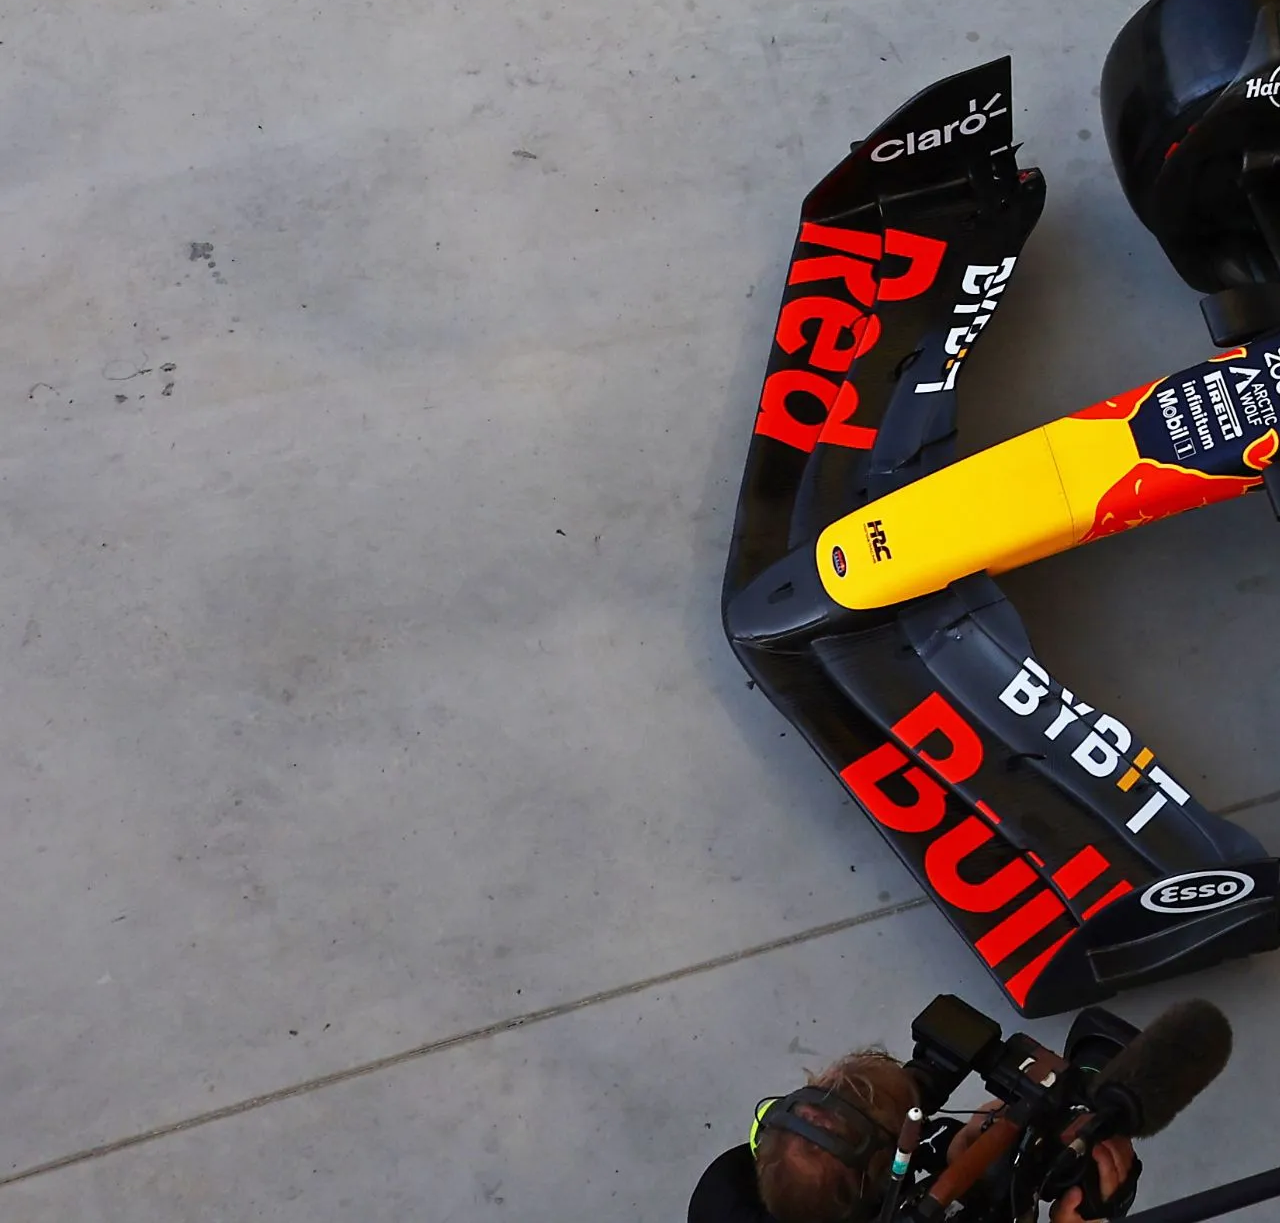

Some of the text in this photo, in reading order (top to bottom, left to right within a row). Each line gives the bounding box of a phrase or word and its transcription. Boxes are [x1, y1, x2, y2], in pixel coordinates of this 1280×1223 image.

[870, 110, 988, 163] Claro
[755, 222, 948, 453] Red
[1156, 387, 1190, 441] Mobil
[1181, 379, 1215, 451] infinitum
[1203, 370, 1243, 441] PIRELLI
[1239, 391, 1263, 427] WOLF
[1250, 382, 1278, 427] ARCTIC
[867, 520, 892, 562] HRC
[999, 657, 1191, 835] BYBIT
[840, 692, 1136, 1008] Bull
[1160, 879, 1239, 903] Esso
